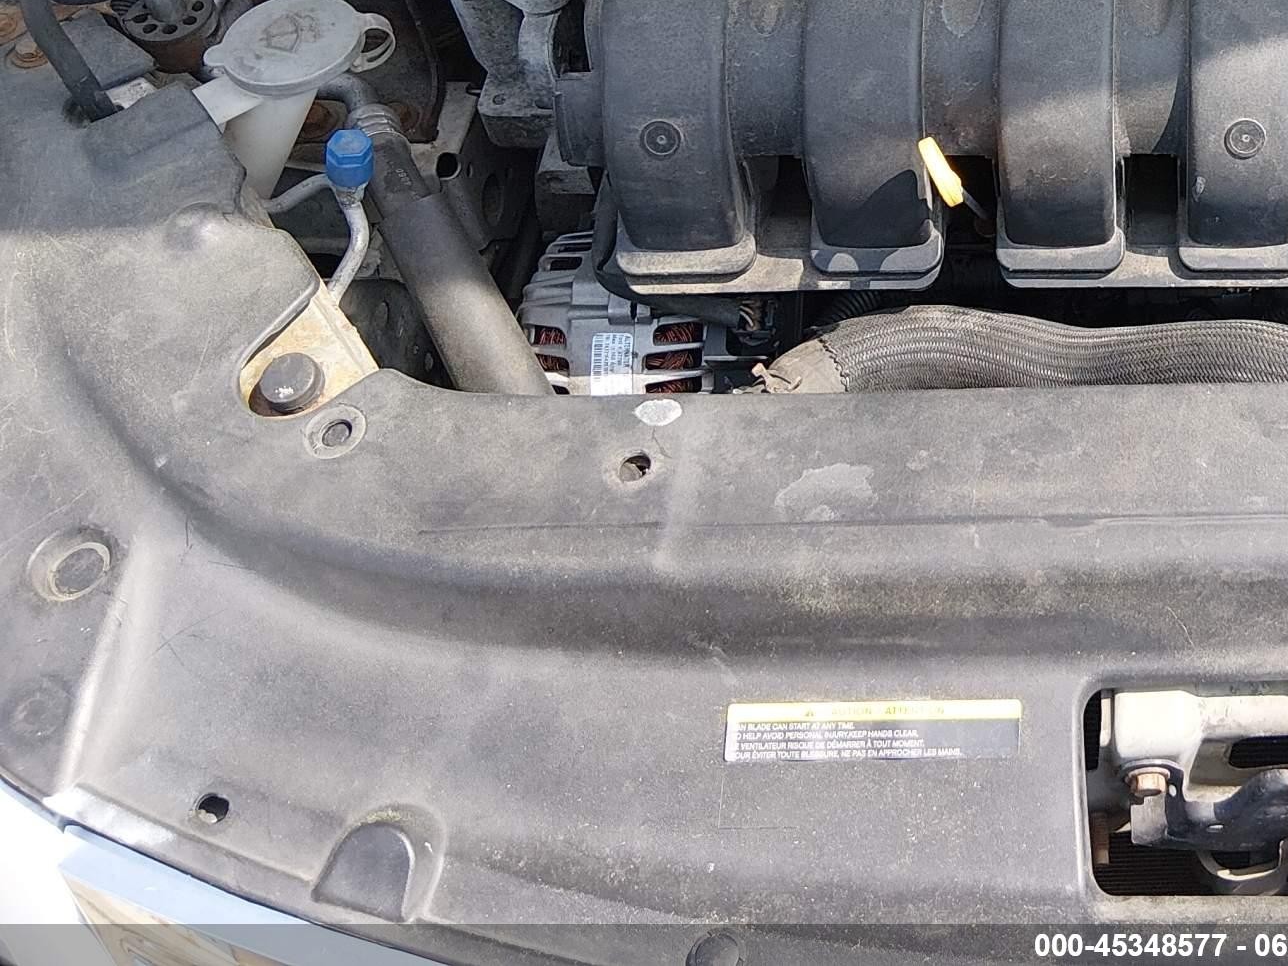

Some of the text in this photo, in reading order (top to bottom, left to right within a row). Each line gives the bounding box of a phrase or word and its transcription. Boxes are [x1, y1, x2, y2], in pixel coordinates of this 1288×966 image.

[748, 722, 771, 731] BLADE
[772, 722, 788, 731] CAN
[789, 721, 811, 730] START
[811, 721, 821, 730] AT
[821, 721, 836, 730] ANY
[743, 732, 762, 740] HELP
[763, 731, 784, 740] AVOID
[786, 730, 824, 740] PERSONAL
[868, 729, 893, 738] HANDS
[741, 741, 787, 750] VENTILATEUR
[787, 741, 814, 750] RISQUE
[873, 739, 891, 748] TOUT
[777, 750, 800, 759] TOUTE
[853, 749, 866, 758] PAS
[878, 748, 922, 757] APPROCHER
[924, 747, 937, 756] LES
